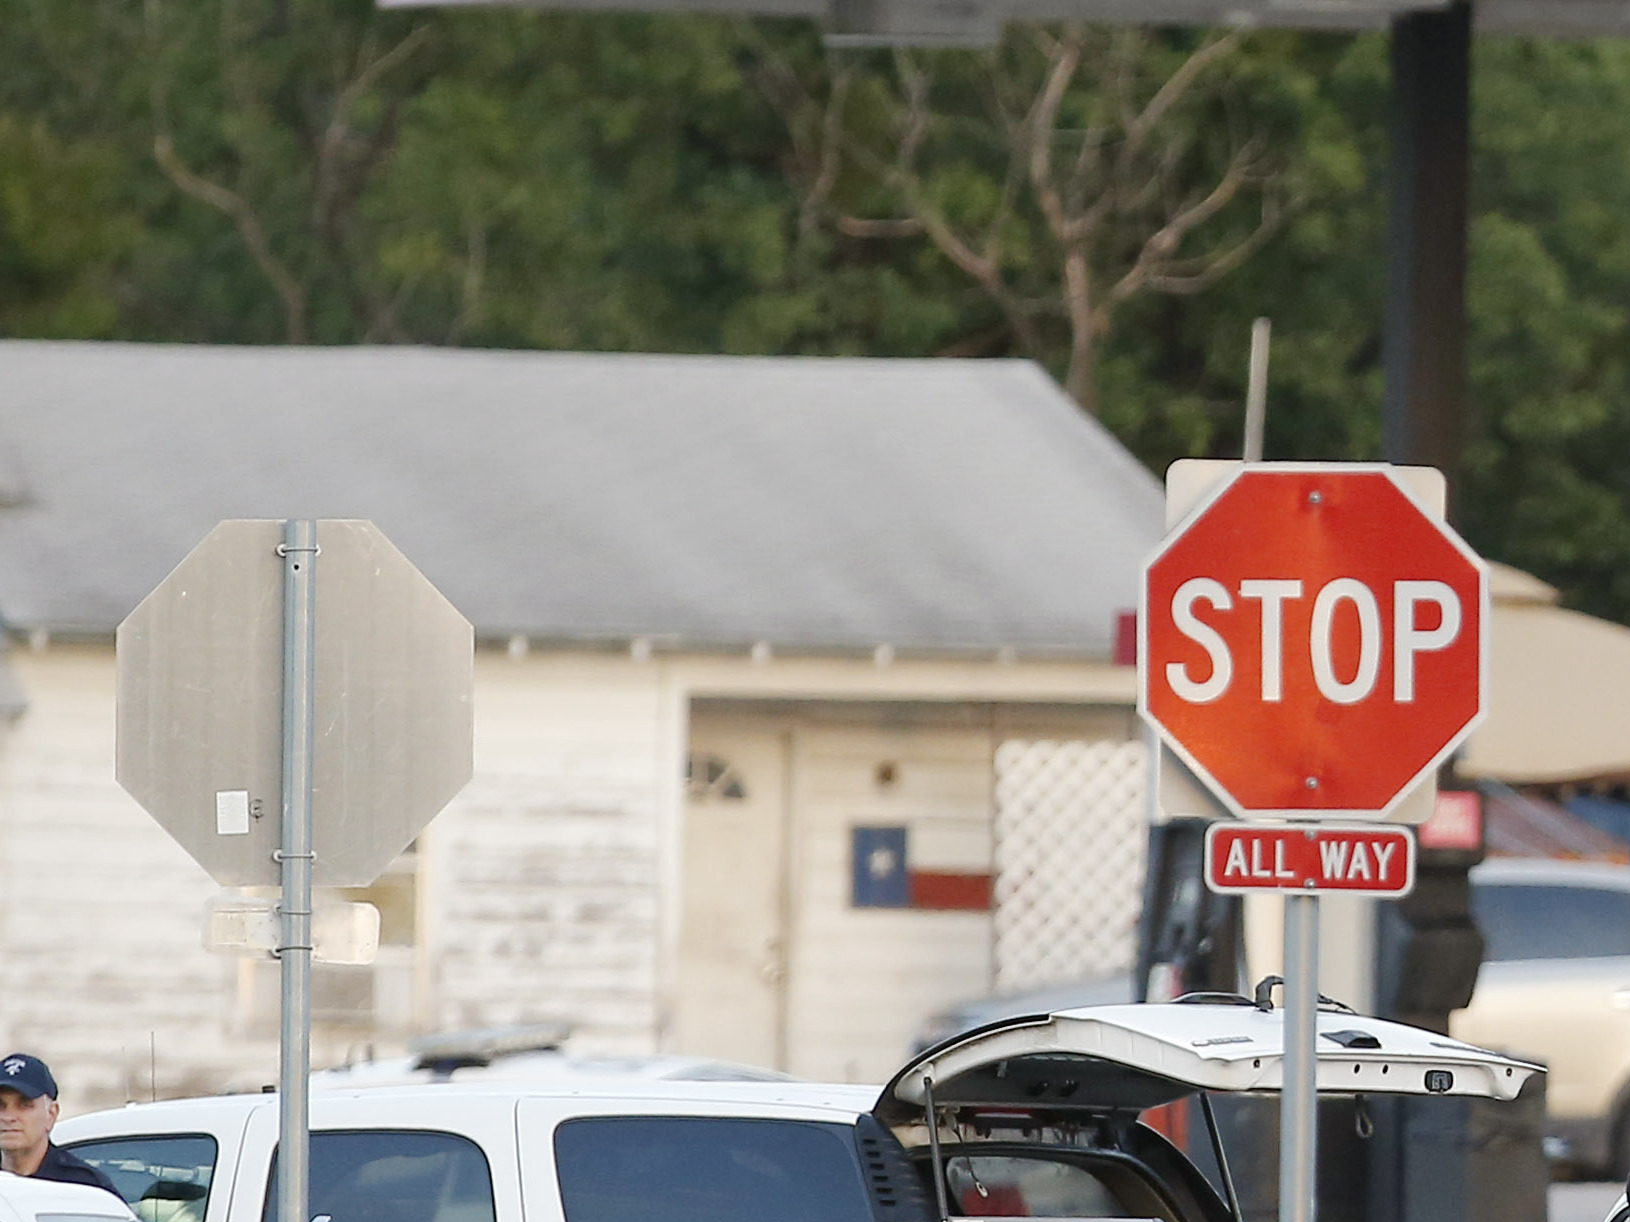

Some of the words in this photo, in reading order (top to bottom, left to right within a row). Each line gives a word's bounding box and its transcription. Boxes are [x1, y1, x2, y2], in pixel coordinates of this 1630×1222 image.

[1166, 577, 1462, 703] STOP
[1224, 838, 1295, 878] ALL
[1319, 840, 1396, 881] WAY
